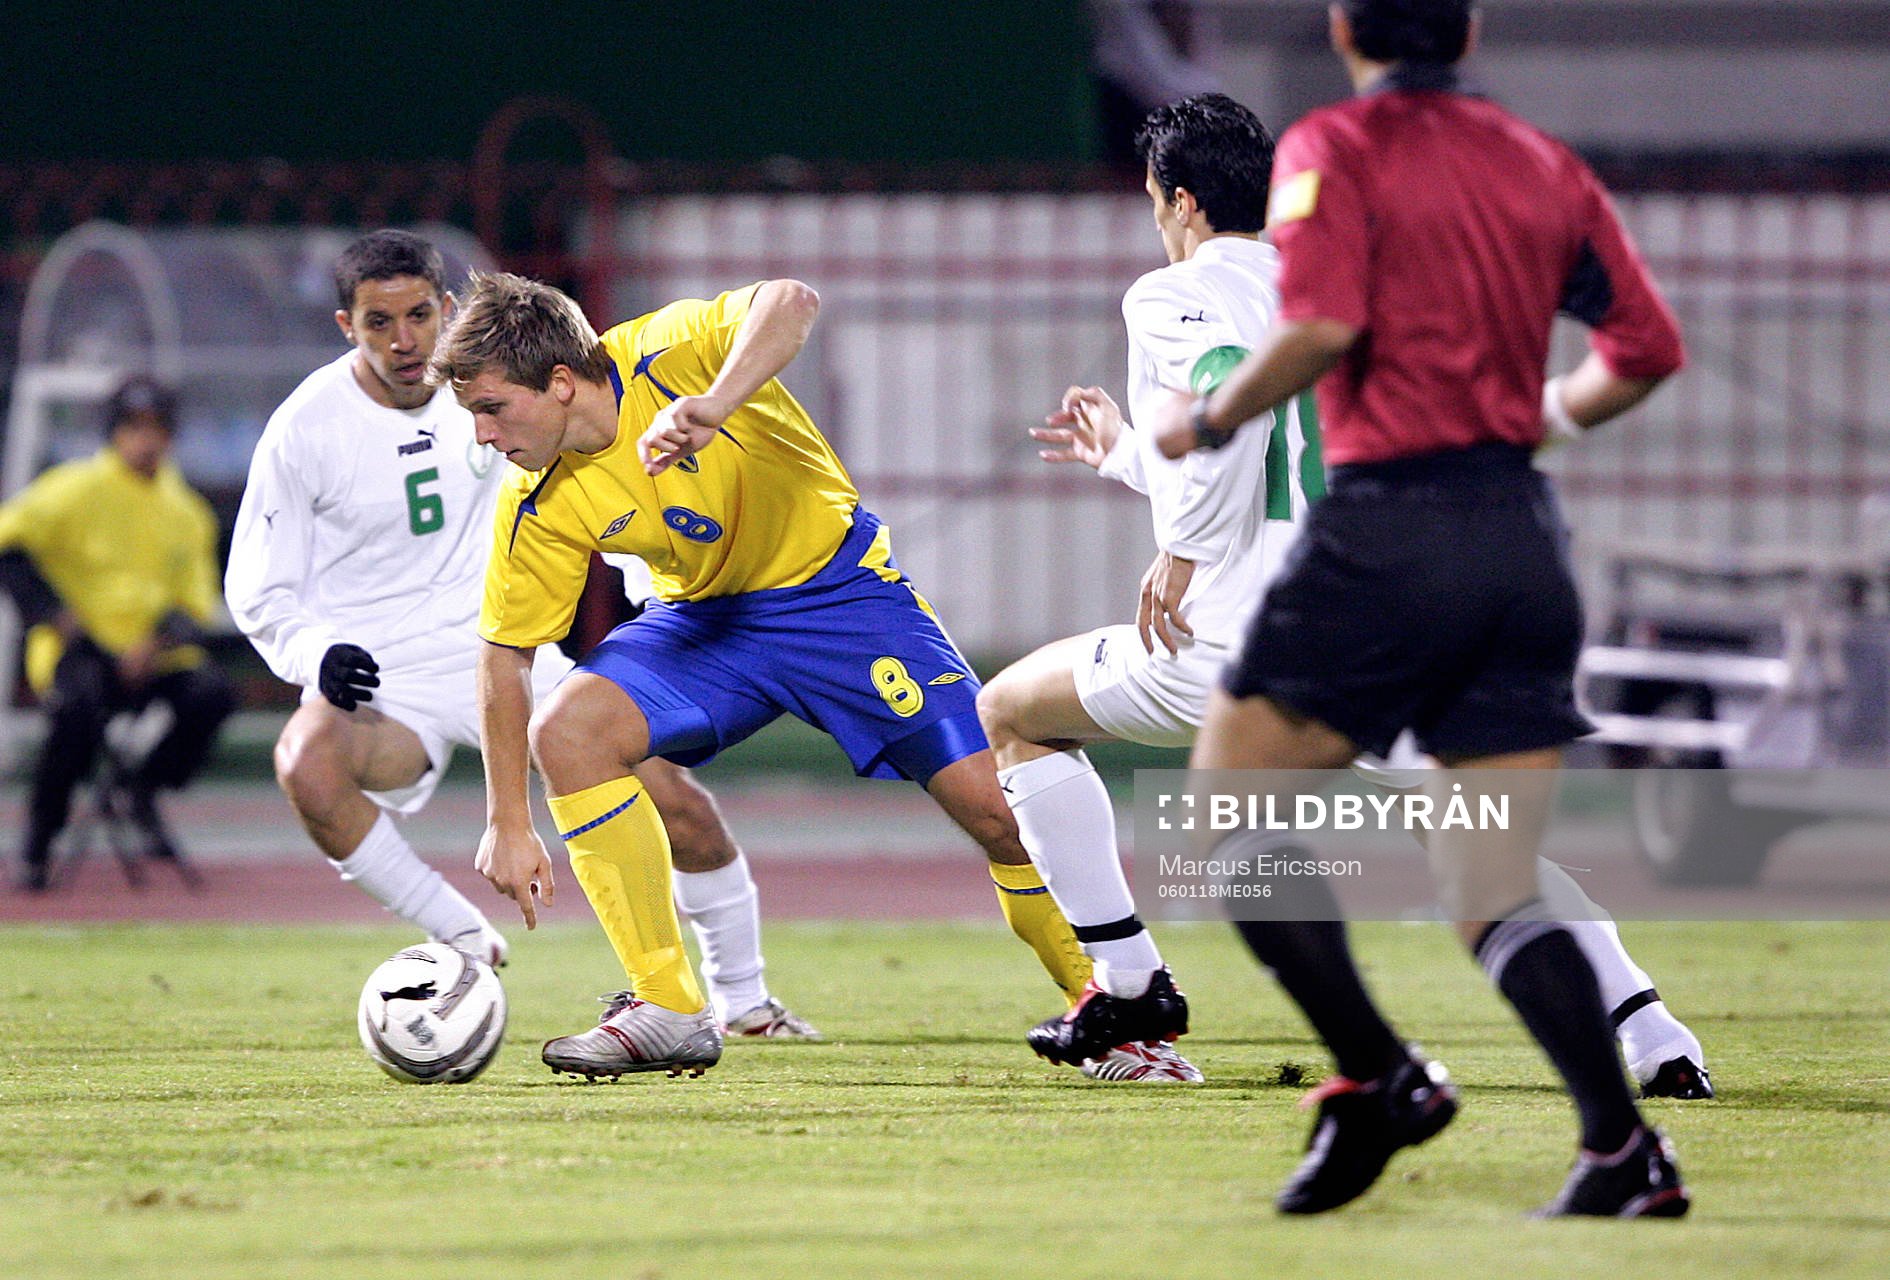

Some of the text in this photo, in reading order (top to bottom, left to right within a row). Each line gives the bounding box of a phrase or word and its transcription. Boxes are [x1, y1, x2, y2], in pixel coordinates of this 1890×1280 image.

[397, 438, 432, 458] PUMA
[405, 467, 445, 536] 6
[662, 505, 723, 544] 8
[870, 656, 925, 718] 8
